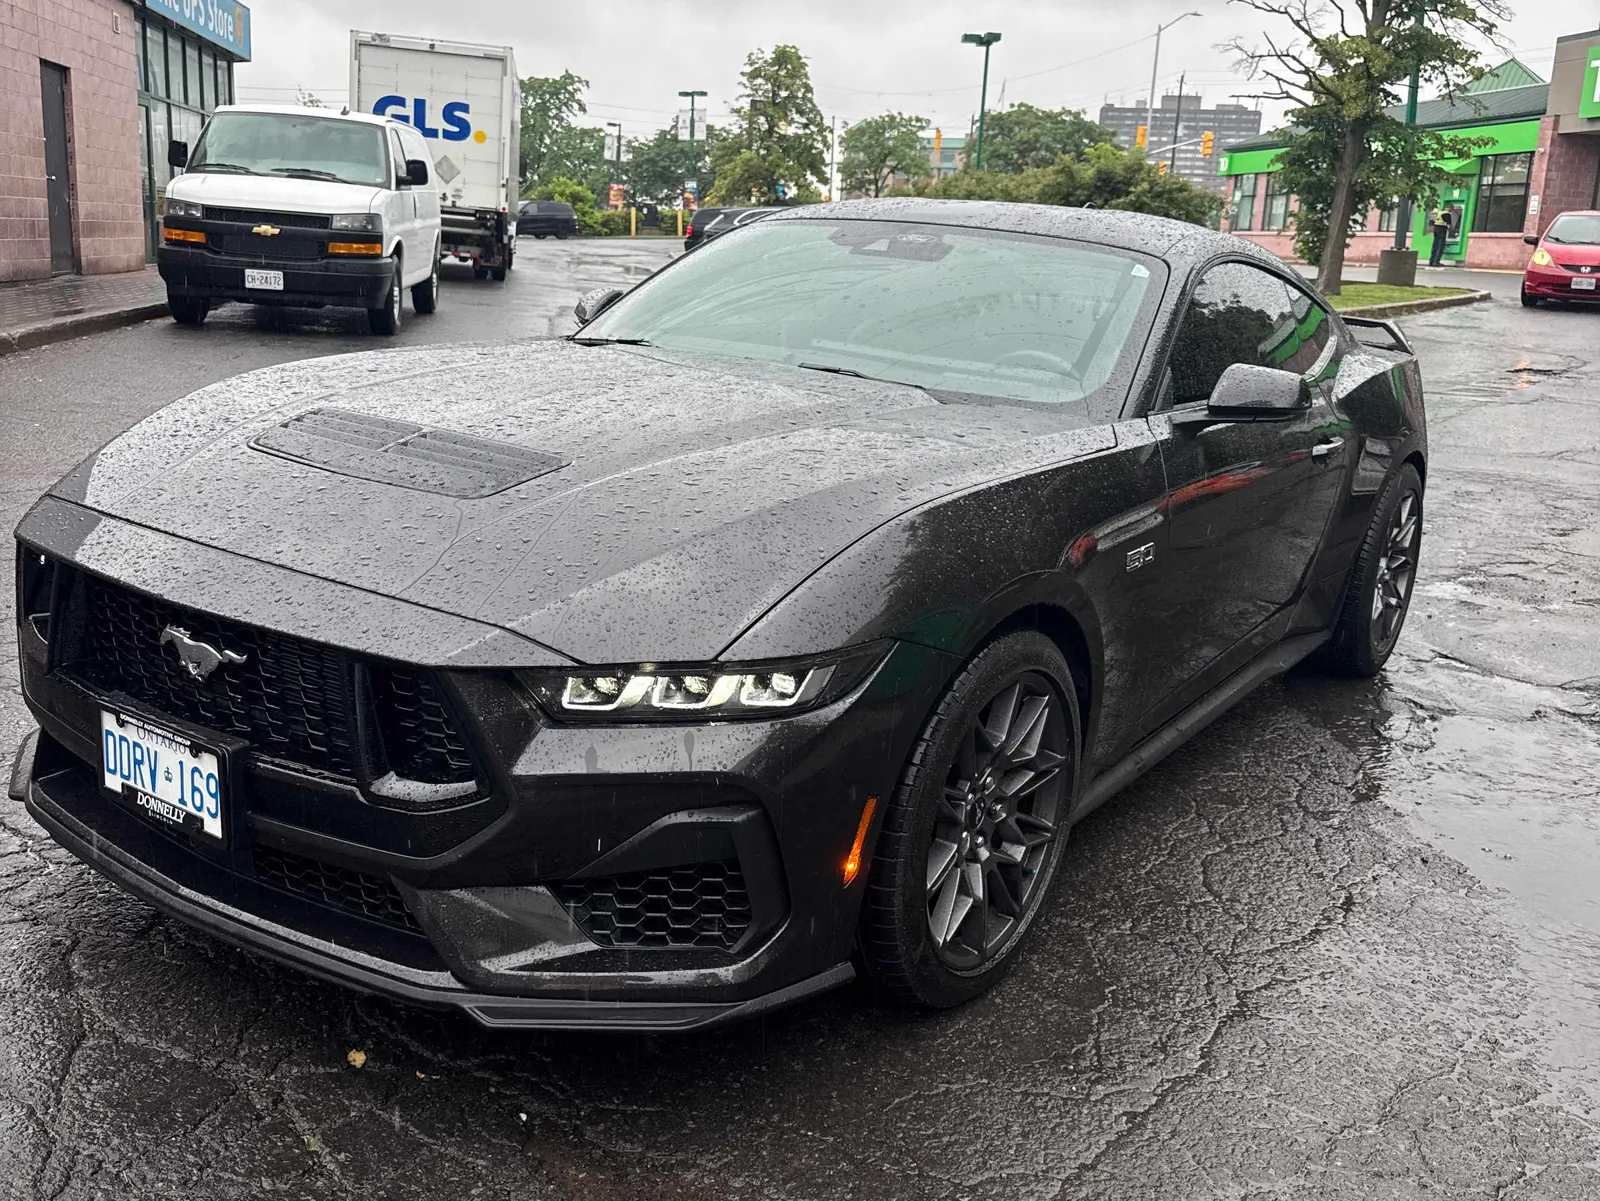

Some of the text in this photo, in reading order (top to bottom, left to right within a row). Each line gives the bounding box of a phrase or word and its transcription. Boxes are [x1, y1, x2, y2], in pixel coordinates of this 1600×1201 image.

[207, 0, 234, 43] Store
[137, 727, 187, 755] ONTARIO
[104, 728, 219, 819] DDRV 169
[137, 791, 187, 824] DONNELLY
